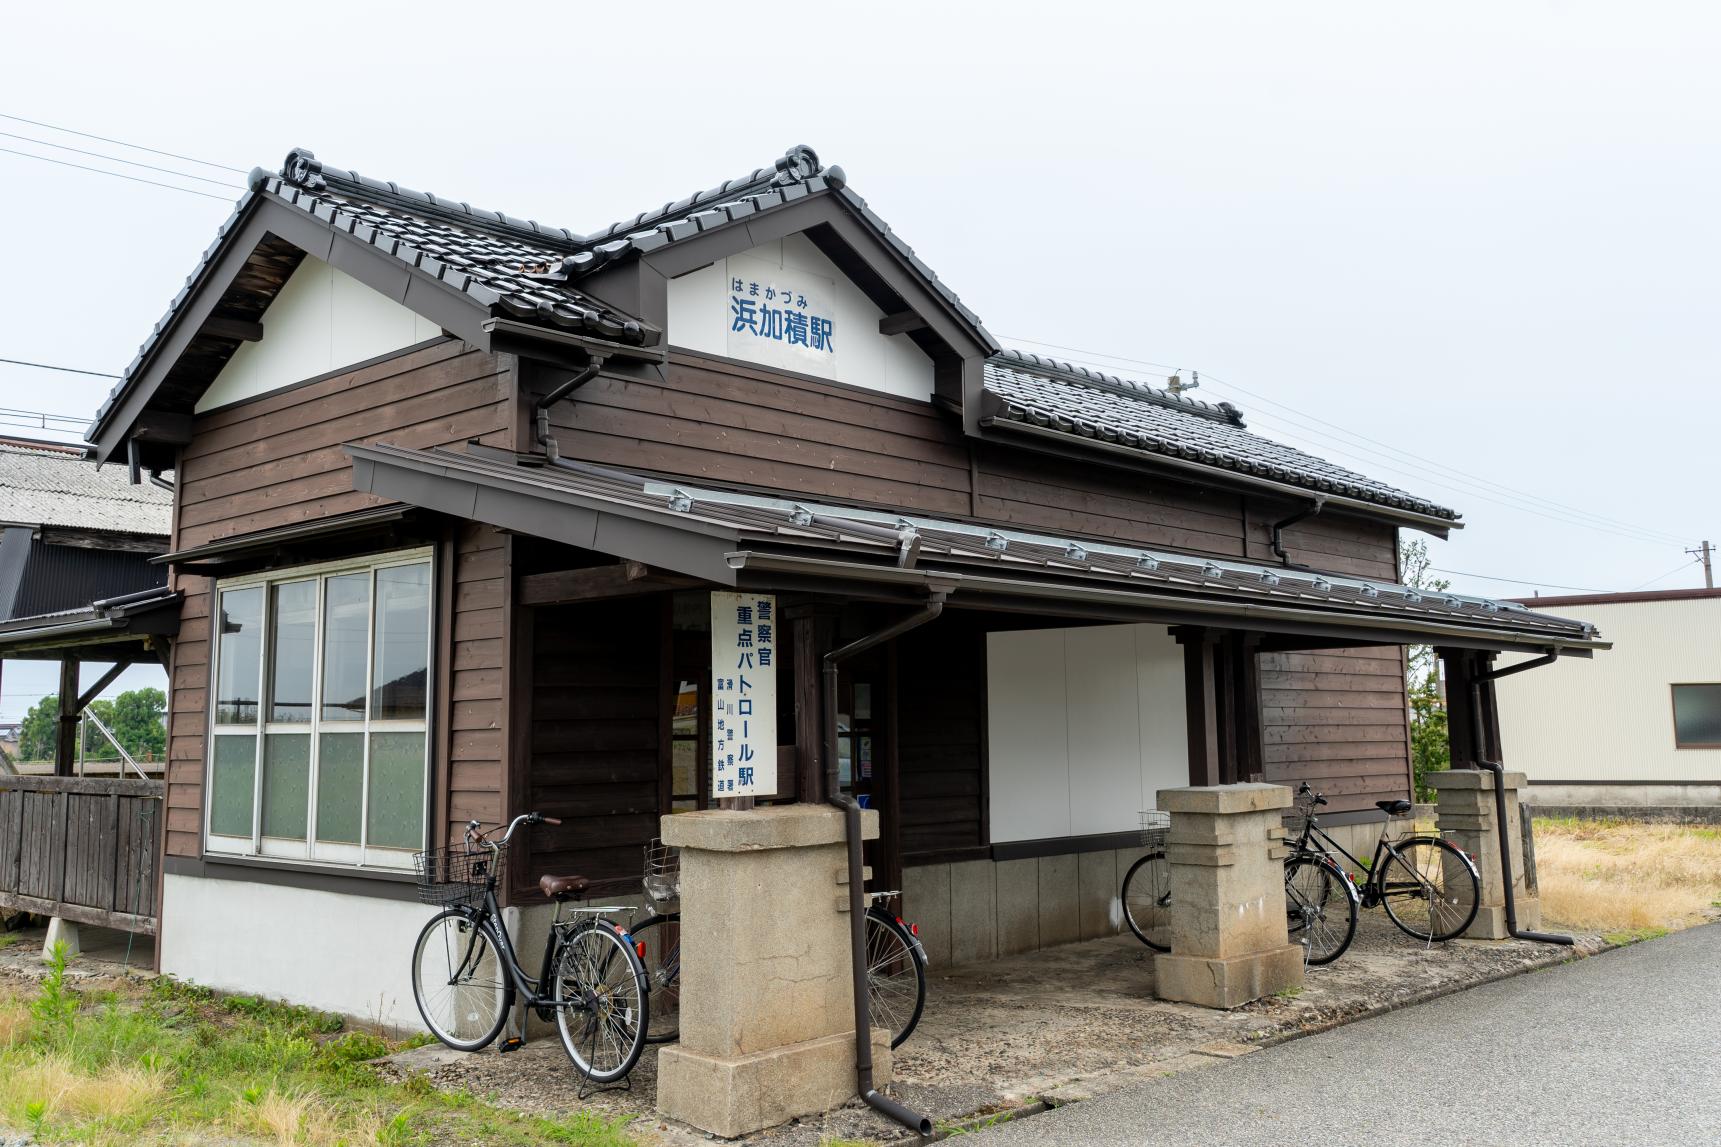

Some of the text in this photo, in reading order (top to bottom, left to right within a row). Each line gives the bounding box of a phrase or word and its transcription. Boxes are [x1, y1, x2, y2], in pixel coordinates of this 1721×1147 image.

[731, 296, 833, 353] 浜加積駅
[732, 277, 808, 309] はまかづみ
[757, 601, 771, 667] 警察官
[736, 606, 754, 786] 重点パトロール駅
[726, 679, 734, 791] 滑川警察署
